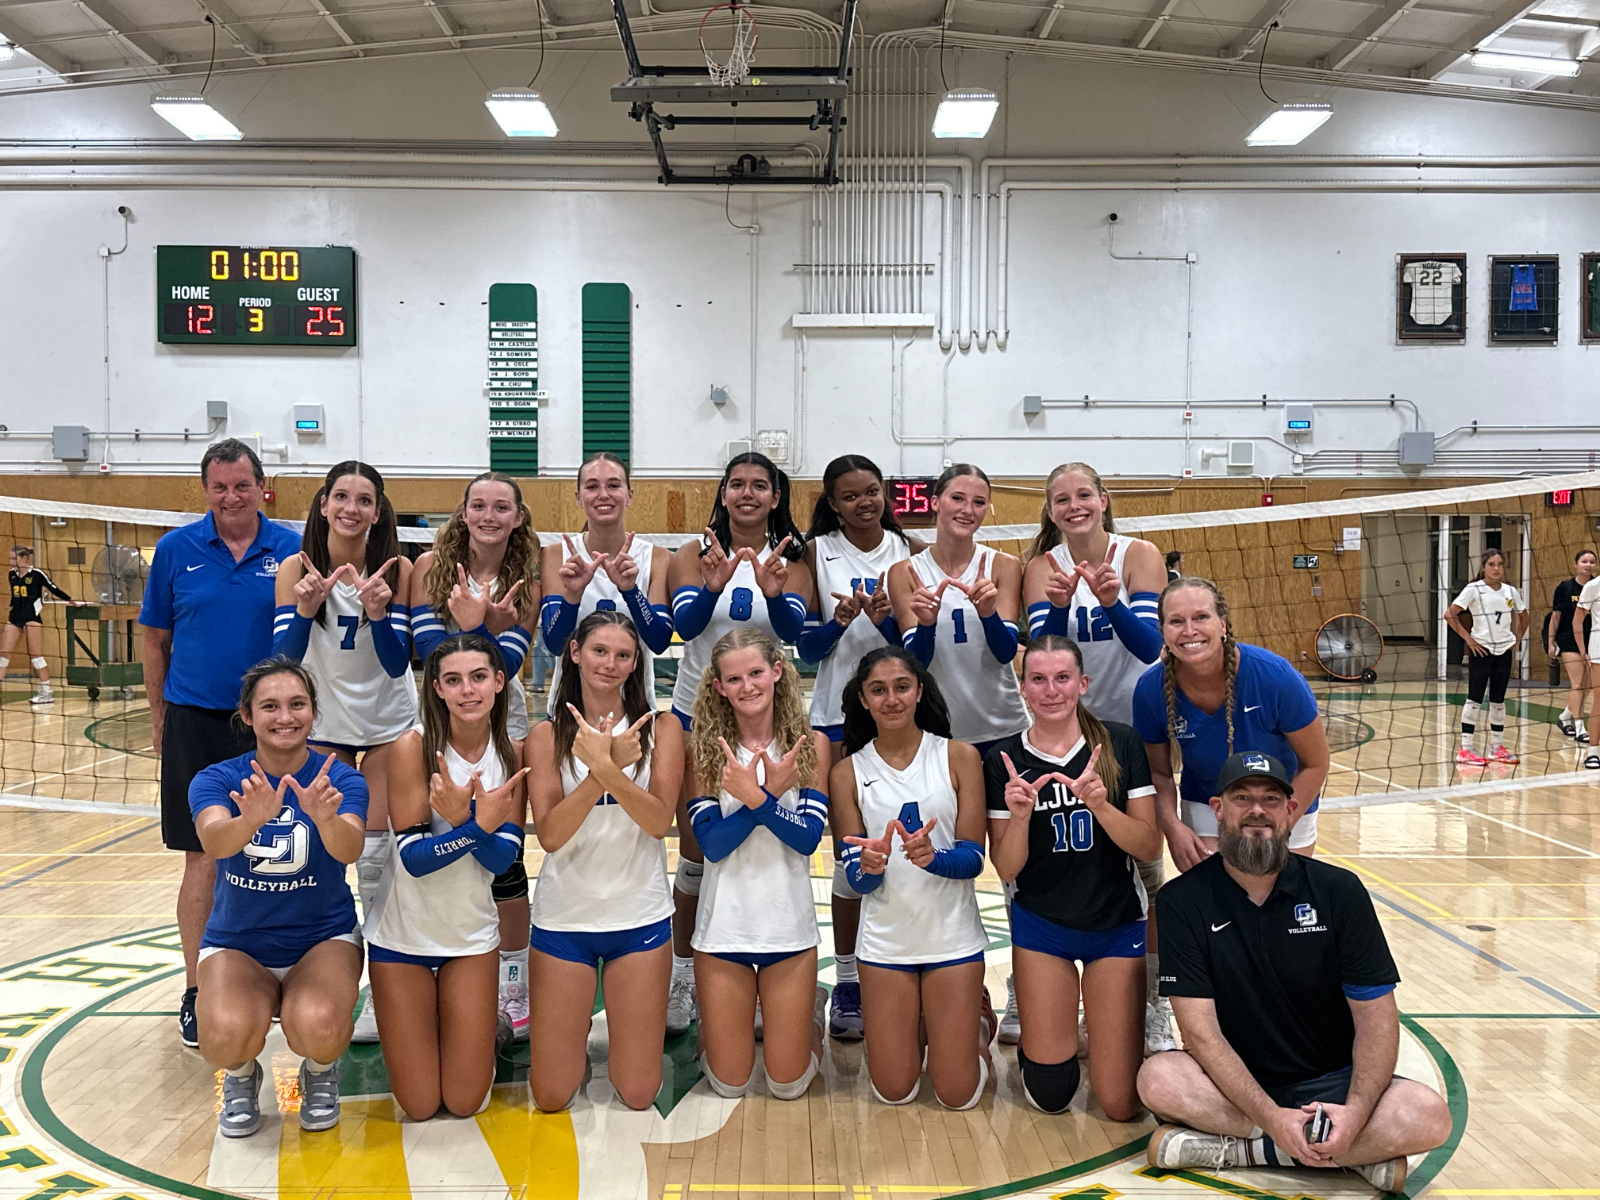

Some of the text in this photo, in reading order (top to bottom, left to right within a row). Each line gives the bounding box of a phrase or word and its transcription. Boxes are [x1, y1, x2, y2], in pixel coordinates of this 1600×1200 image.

[211, 250, 299, 281] 01:00
[1420, 270, 1442, 286] 22
[172, 286, 210, 300] HOME
[297, 287, 340, 302] GUEST
[1514, 283, 1533, 294] USA
[239, 297, 271, 308] PERIOD
[187, 304, 214, 334] 12
[249, 308, 263, 333] 3
[306, 306, 344, 336] 25
[894, 484, 929, 513] 35
[1553, 490, 1572, 504] EXIT
[13, 585, 28, 597] 20
[729, 587, 753, 621] 8
[951, 608, 968, 644] 1
[1075, 606, 1114, 642] 12
[1495, 611, 1503, 625] 7
[337, 615, 359, 650] 7
[1034, 782, 1085, 811] LJC
[897, 801, 923, 834] 4
[1050, 808, 1094, 853] 10
[434, 836, 476, 856] TORREYS
[225, 870, 317, 892] VOLLEYBALL
[1288, 925, 1328, 935] VOLLEYBALL
